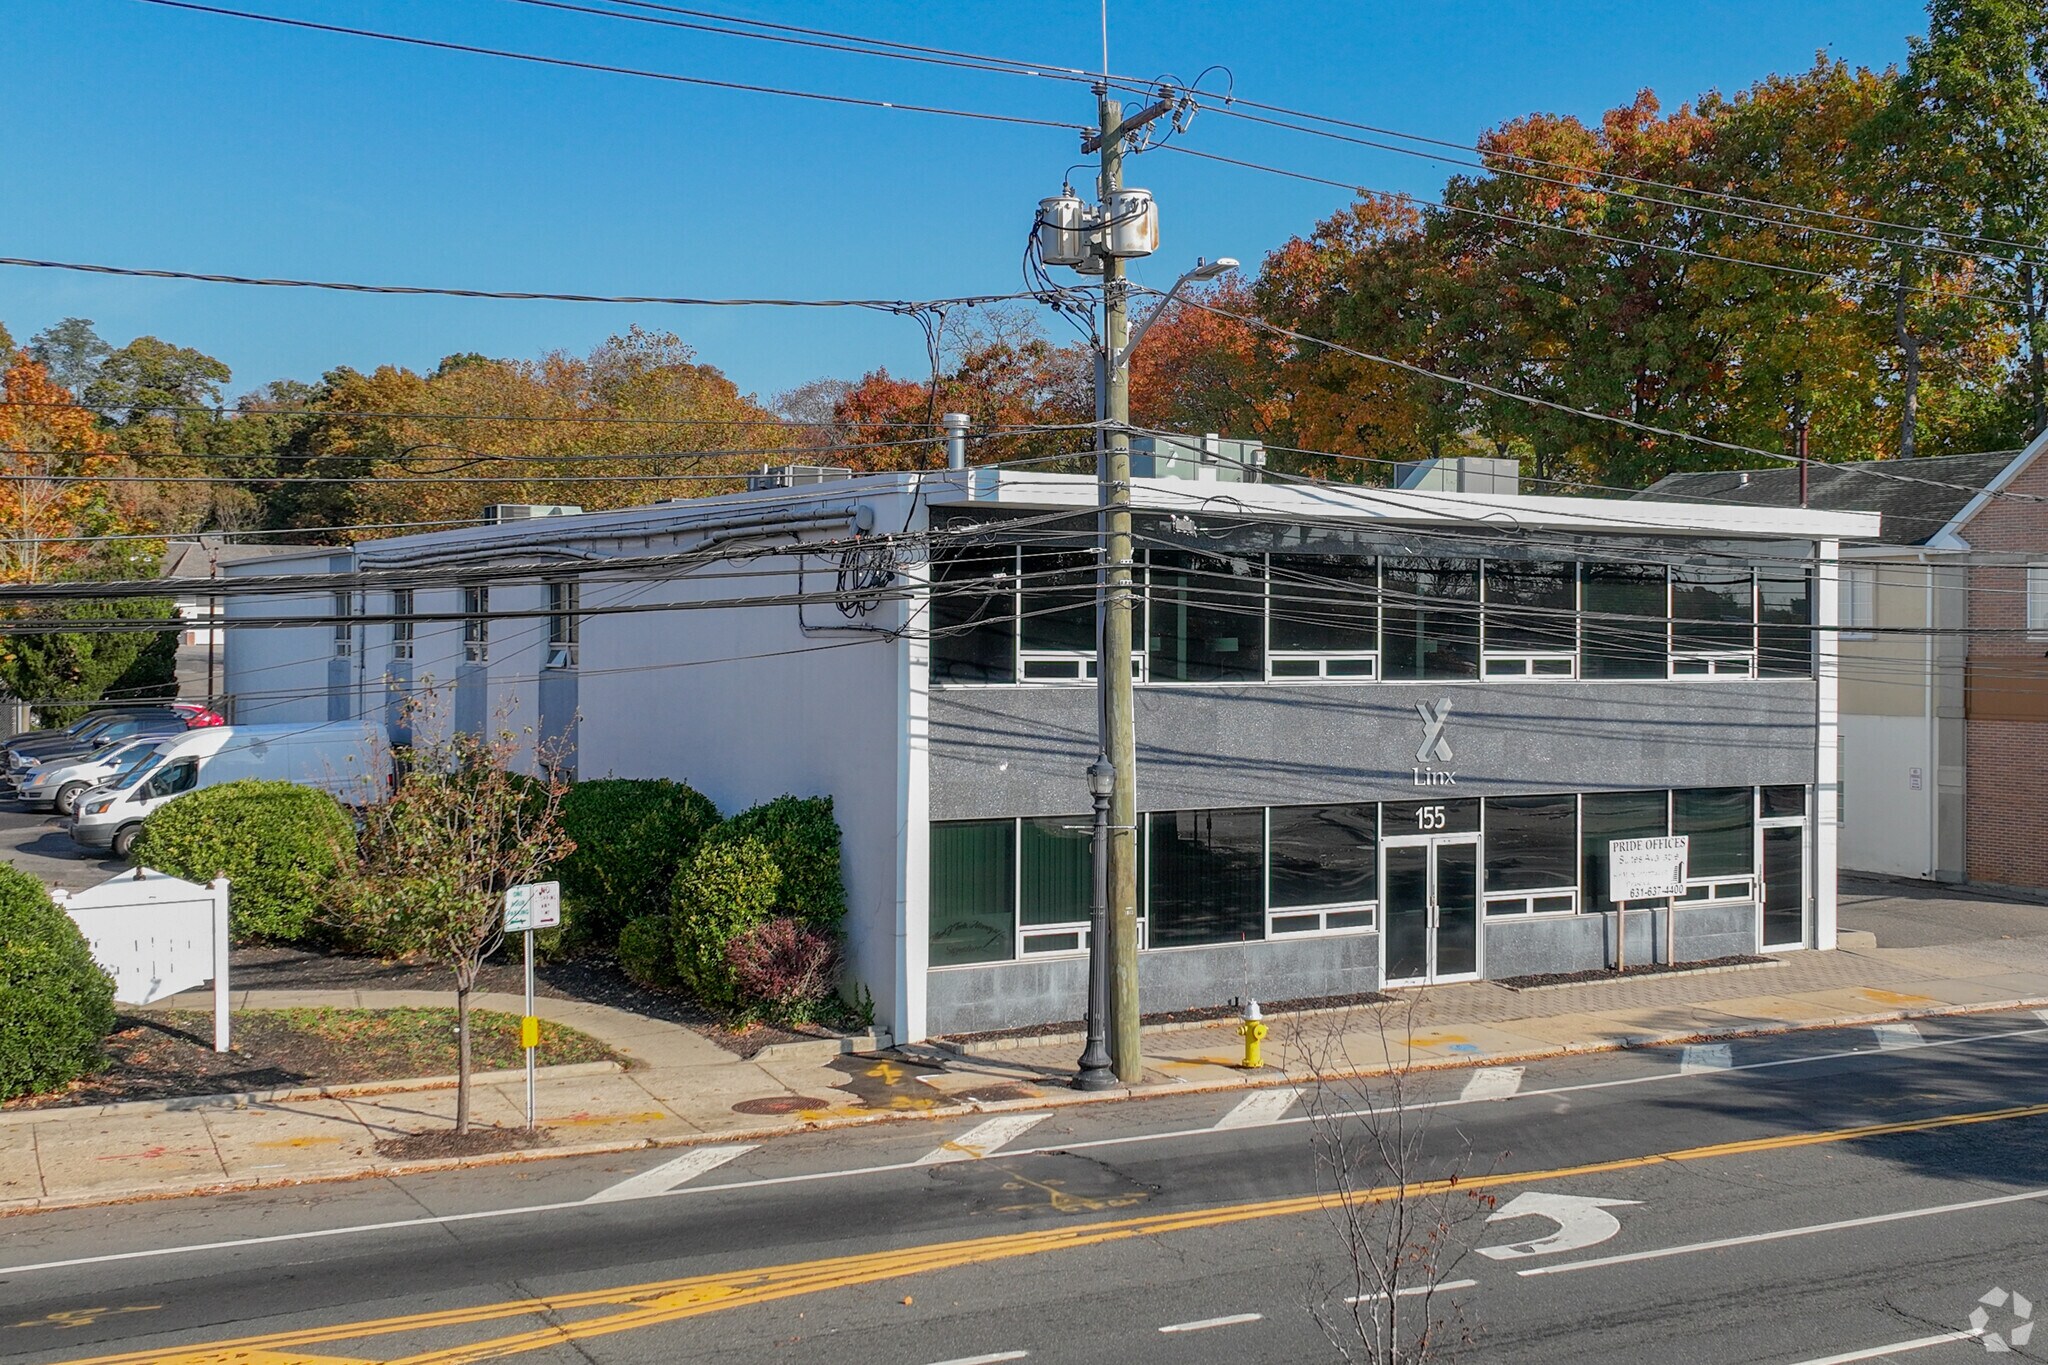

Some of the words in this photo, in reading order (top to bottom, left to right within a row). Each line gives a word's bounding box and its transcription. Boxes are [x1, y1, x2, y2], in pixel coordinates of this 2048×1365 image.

[1412, 767, 1457, 786] Linx
[1415, 805, 1446, 830] 155
[1613, 840, 1643, 852] PRIDE
[1645, 837, 1686, 850] OFFICES
[1630, 884, 1684, 898] 631-637-4400
